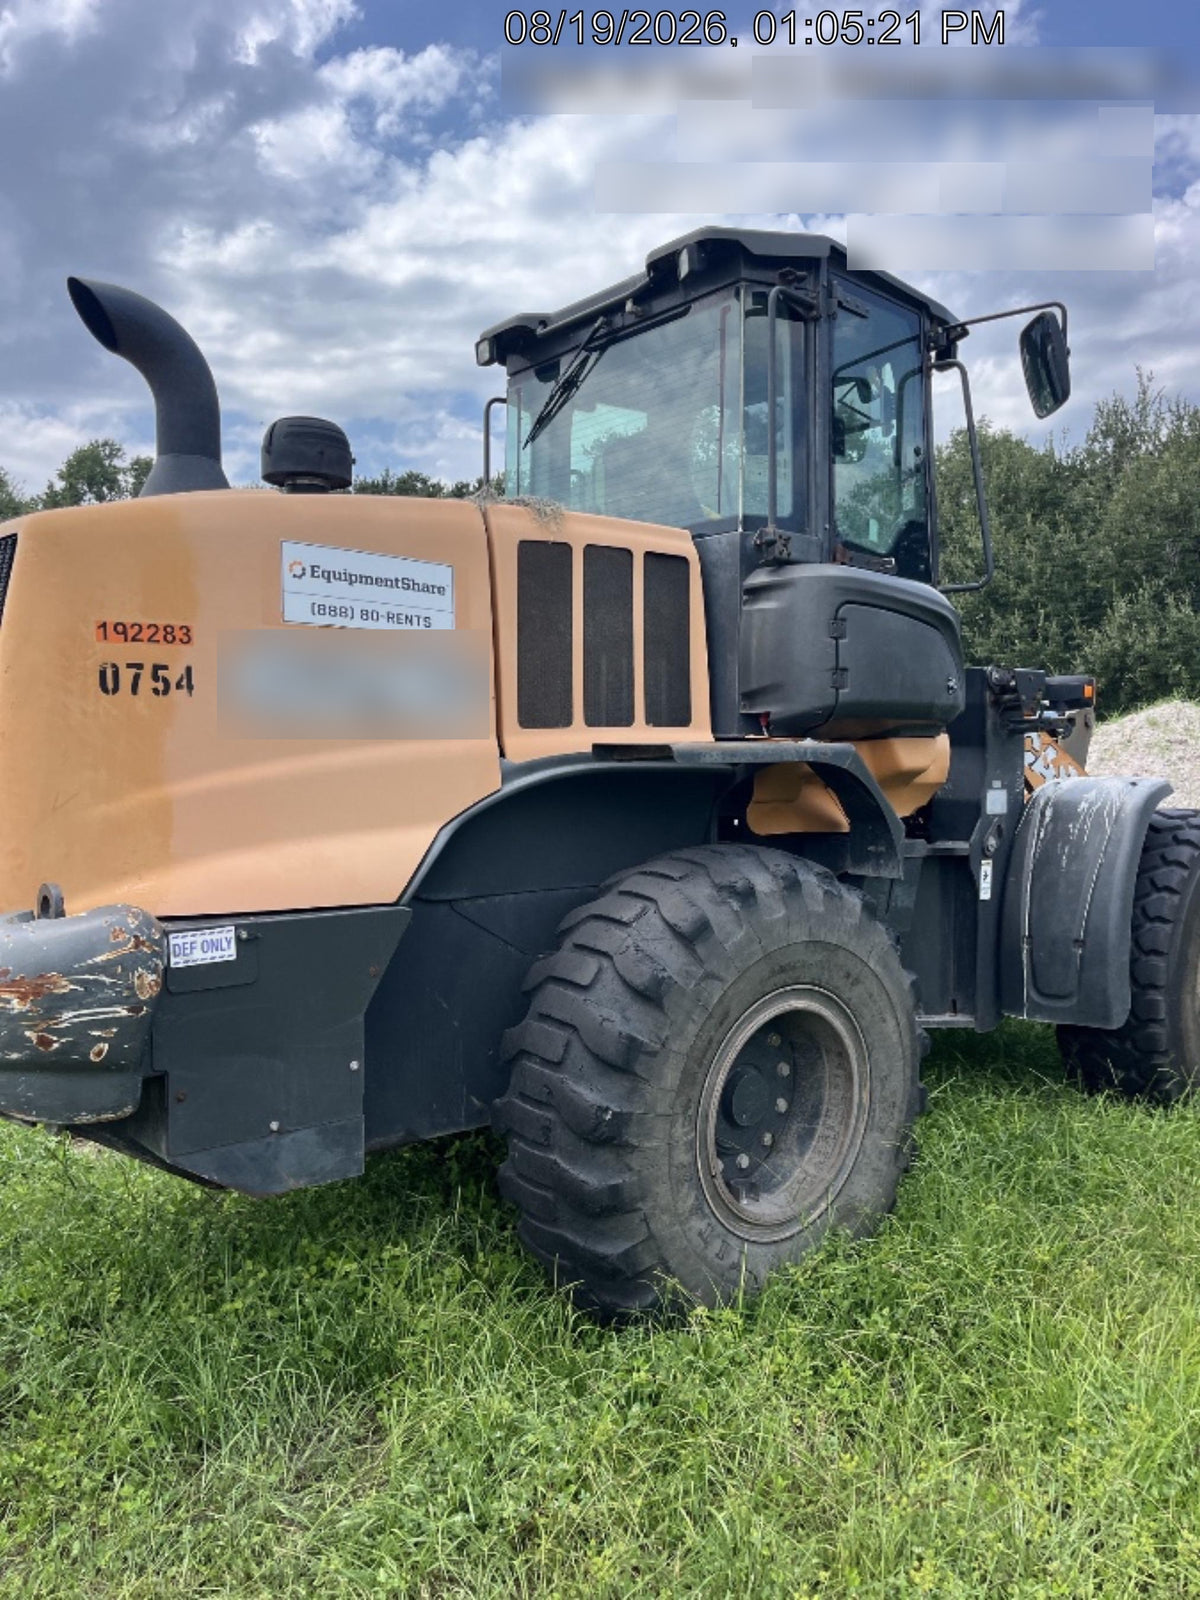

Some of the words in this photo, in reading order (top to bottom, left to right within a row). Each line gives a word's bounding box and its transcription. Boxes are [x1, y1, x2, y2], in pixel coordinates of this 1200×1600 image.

[310, 565, 446, 595] EquipmentShare
[311, 602, 354, 620] (888)
[360, 609, 432, 628] 80-RENTS
[97, 621, 192, 644] 192283
[99, 662, 194, 697] 0754
[172, 941, 197, 958] DEF
[200, 936, 233, 954] ONLY
